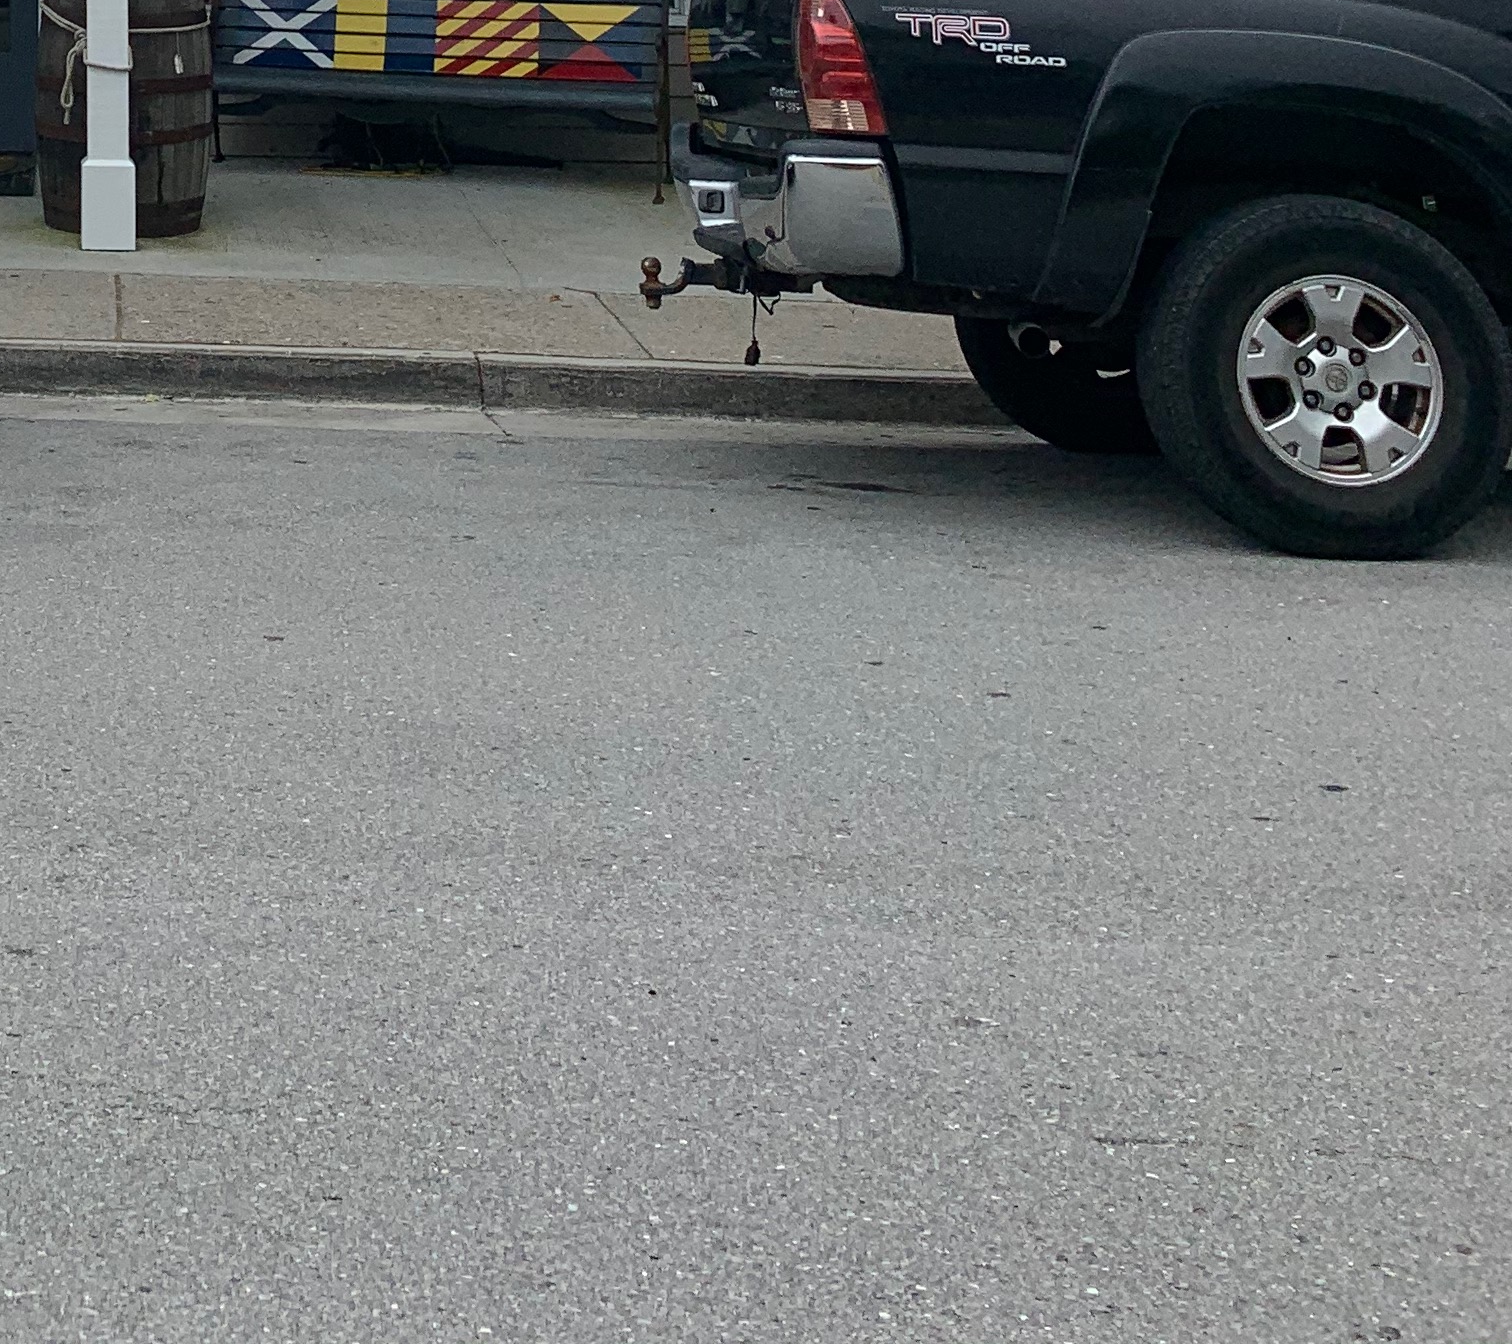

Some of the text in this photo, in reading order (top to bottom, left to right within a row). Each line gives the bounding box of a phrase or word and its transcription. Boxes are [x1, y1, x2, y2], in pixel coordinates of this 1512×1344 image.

[895, 12, 1011, 47] TRD
[979, 42, 1032, 54] OFF
[995, 54, 1069, 69] ROAD
